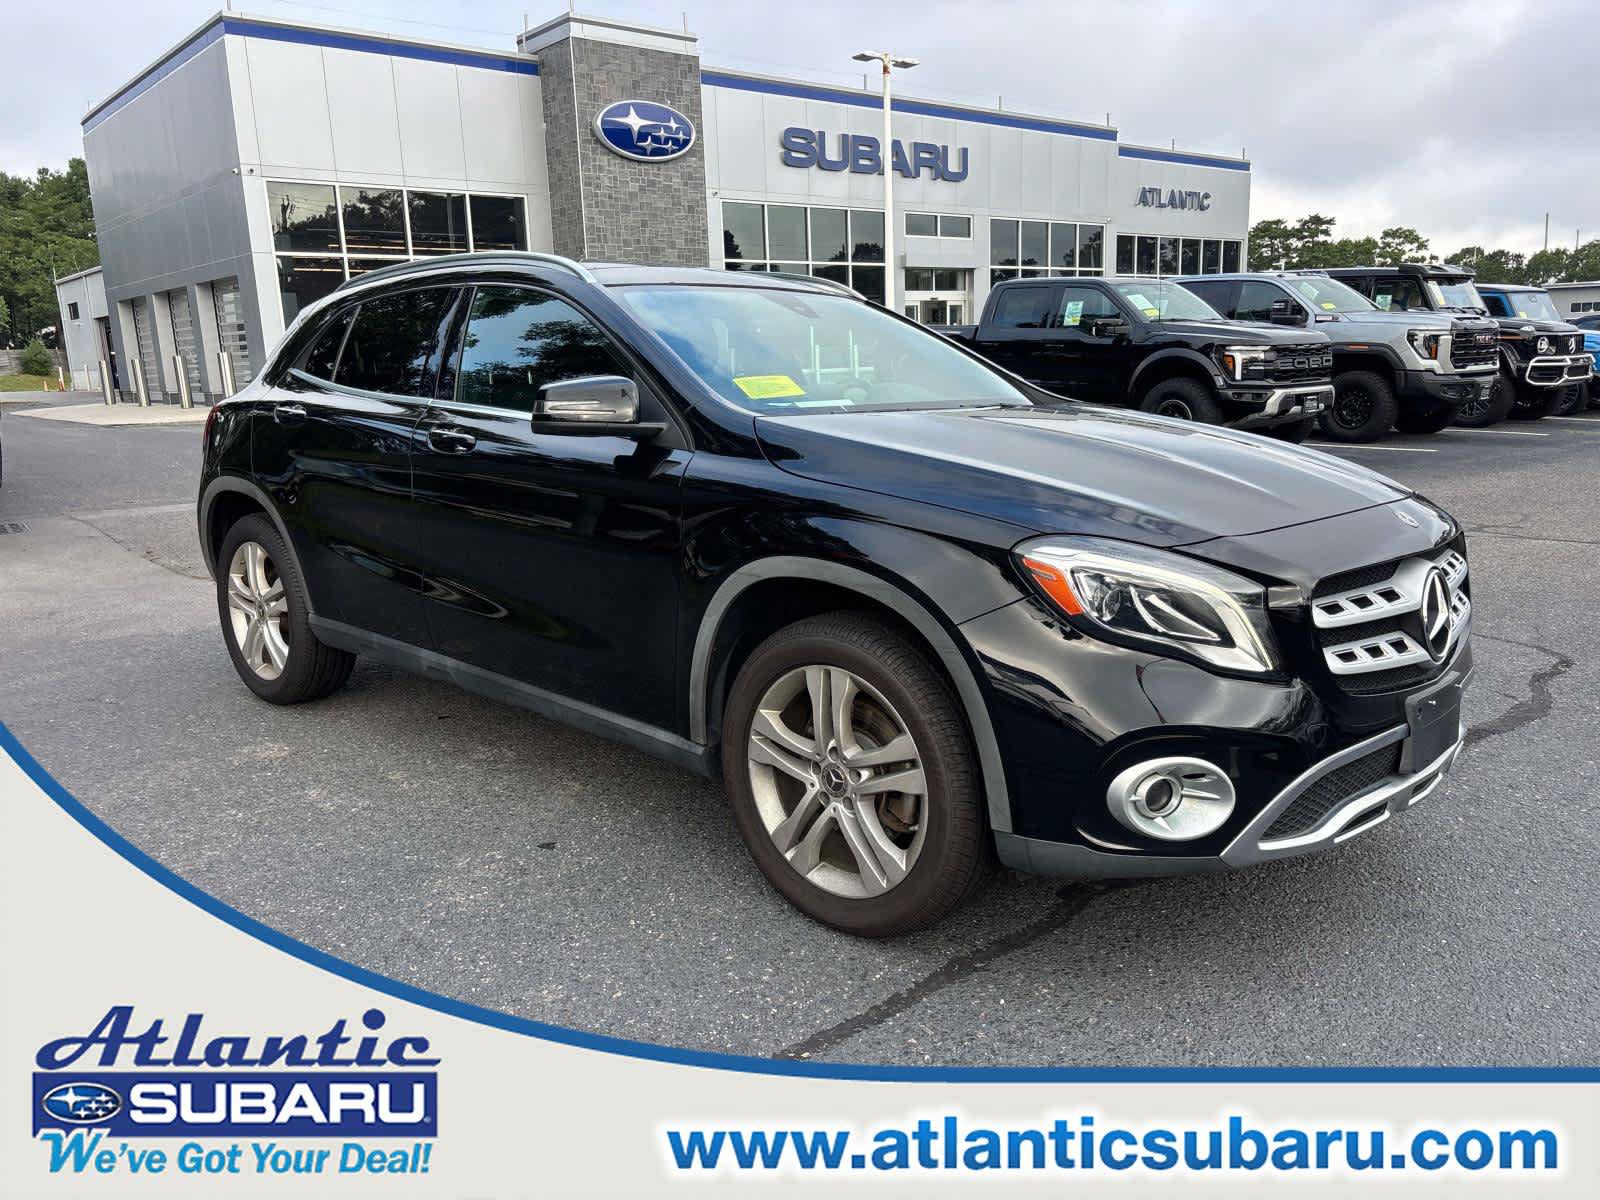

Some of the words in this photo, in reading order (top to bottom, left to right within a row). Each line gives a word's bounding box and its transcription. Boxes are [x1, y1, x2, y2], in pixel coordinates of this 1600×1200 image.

[780, 127, 969, 182] SUBARU
[1136, 186, 1211, 211] ATLANTIC
[1274, 354, 1333, 370] FORD
